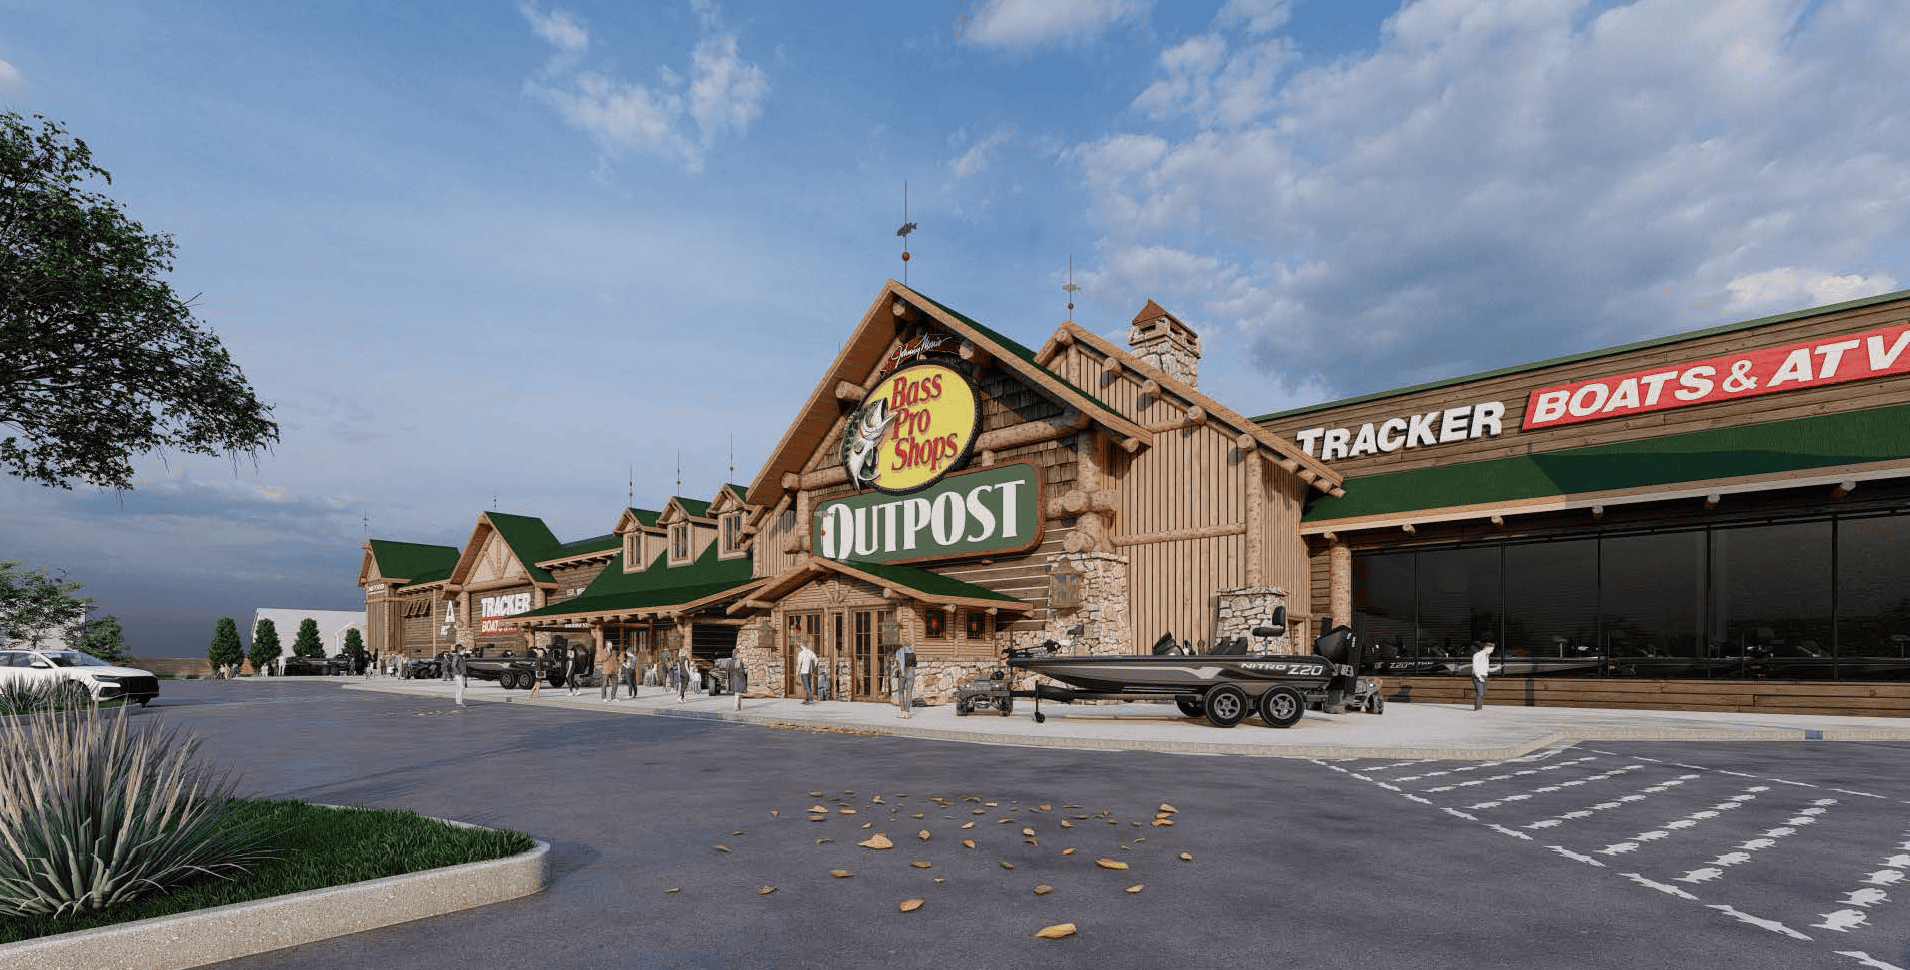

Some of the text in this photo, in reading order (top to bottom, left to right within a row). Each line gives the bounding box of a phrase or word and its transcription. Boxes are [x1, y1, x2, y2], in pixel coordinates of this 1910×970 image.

[891, 343, 921, 369] Johnny
[890, 373, 942, 410] Bass
[892, 406, 931, 440] Pro
[1295, 400, 1505, 461] TRACKER
[1532, 365, 1716, 424] BOATS
[1721, 359, 1758, 393] &
[891, 433, 958, 472] Shops
[822, 480, 1025, 560] OUTPOST
[481, 592, 531, 618] TRACKER
[1240, 662, 1324, 677] NITRO Z20
